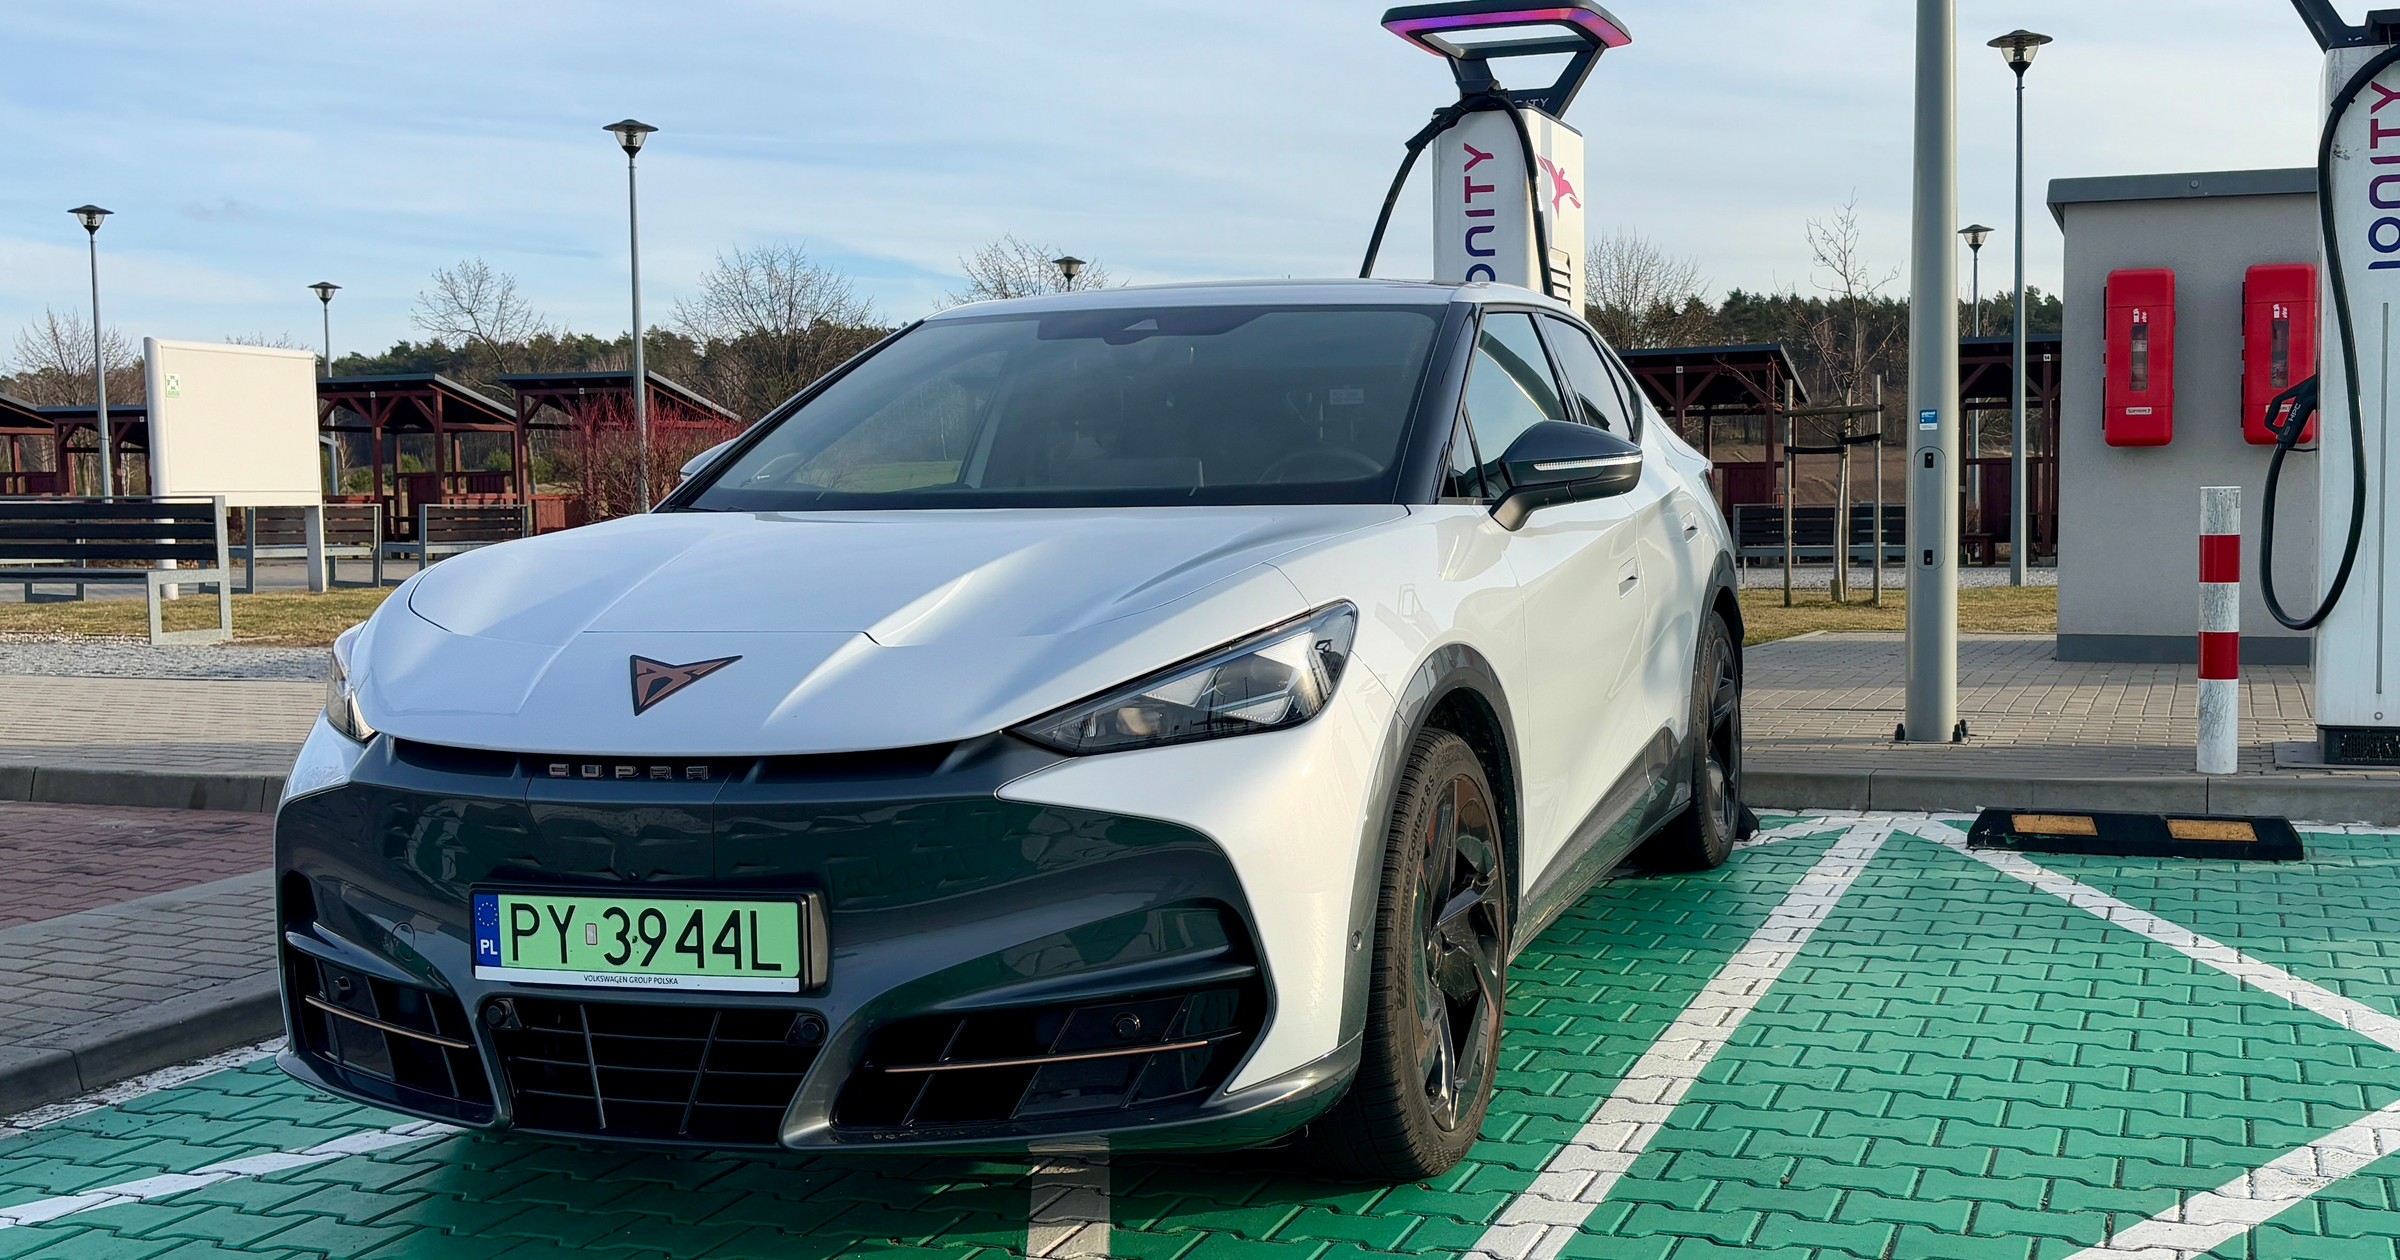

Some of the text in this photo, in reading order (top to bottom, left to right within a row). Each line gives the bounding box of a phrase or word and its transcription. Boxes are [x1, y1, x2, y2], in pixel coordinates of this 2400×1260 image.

[2368, 80, 2400, 270] IONITY
[1463, 142, 1496, 282] ONITY
[549, 763, 709, 781] CUPRA
[480, 939, 498, 955] PL
[511, 903, 782, 971] PY 3944L
[583, 974, 679, 985] VOLKSWAGEN GROUP POLSKA
